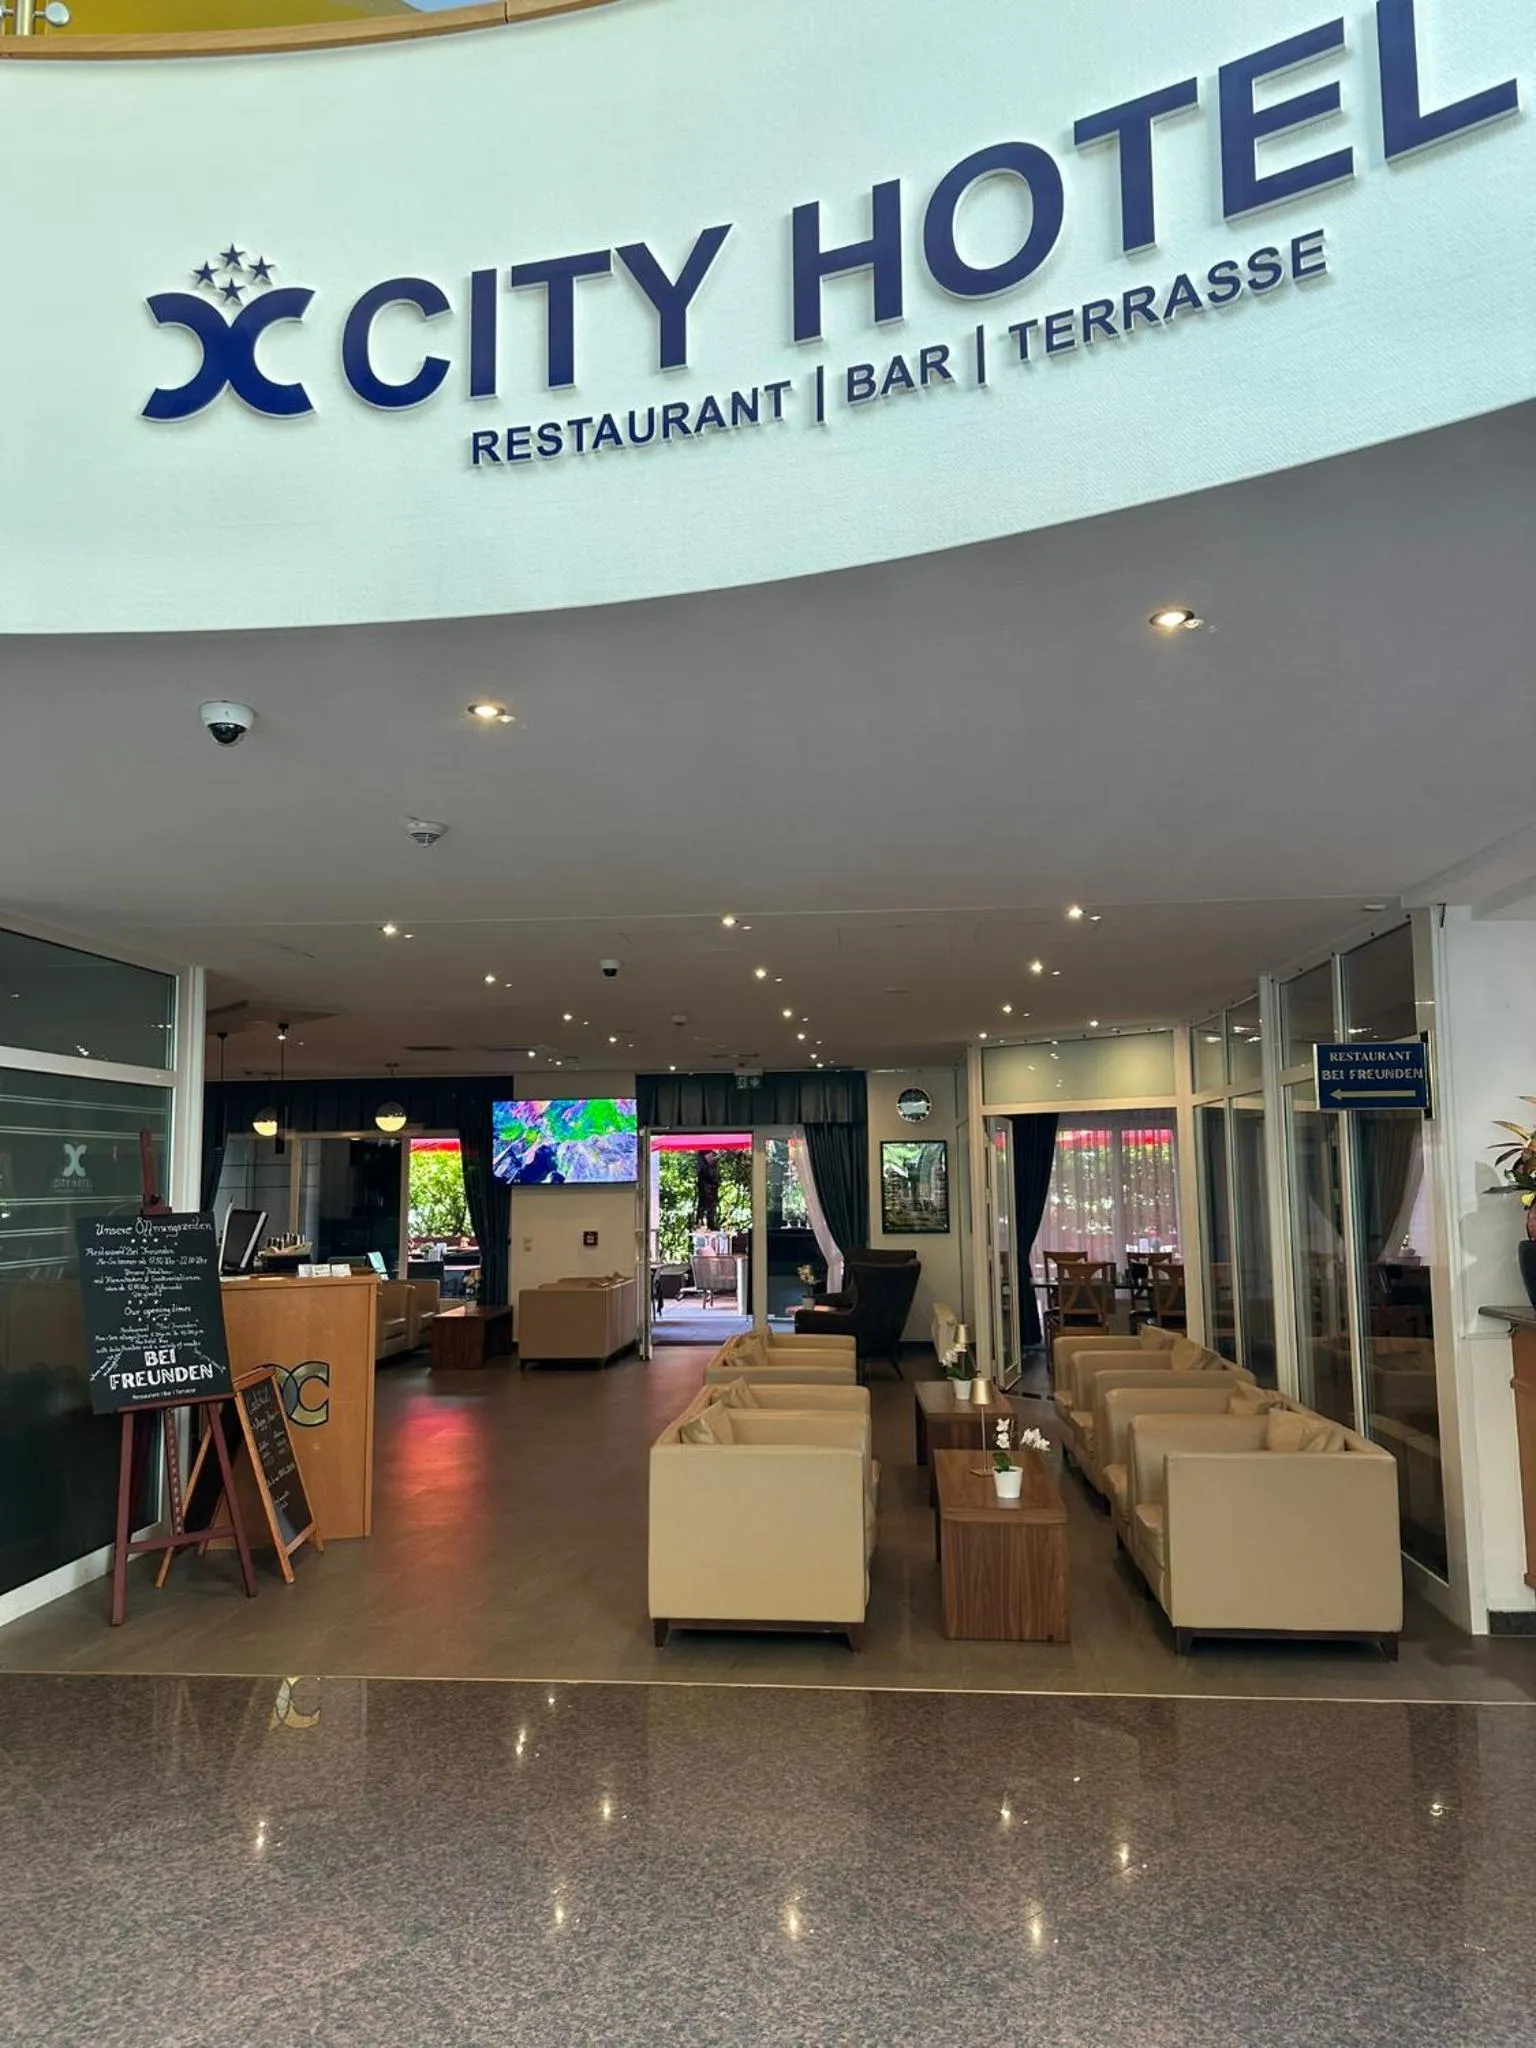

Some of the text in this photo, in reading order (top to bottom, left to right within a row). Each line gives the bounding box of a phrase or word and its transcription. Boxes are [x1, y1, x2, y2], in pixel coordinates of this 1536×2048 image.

[342, 0, 1519, 411] CITY HOTEL
[472, 380, 792, 466] RESTAURANT
[847, 345, 953, 404] BAR
[1009, 229, 1328, 361] TERRASSE
[1330, 1051, 1412, 1062] RESTAURANT
[1322, 1068, 1423, 1080] BEI FREUNDEN
[95, 1223, 133, 1235] Unsere
[124, 1306, 140, 1316] Our
[142, 1306, 172, 1318] opening
[144, 1348, 176, 1366] BEI
[109, 1363, 214, 1390] FREUNDEN
